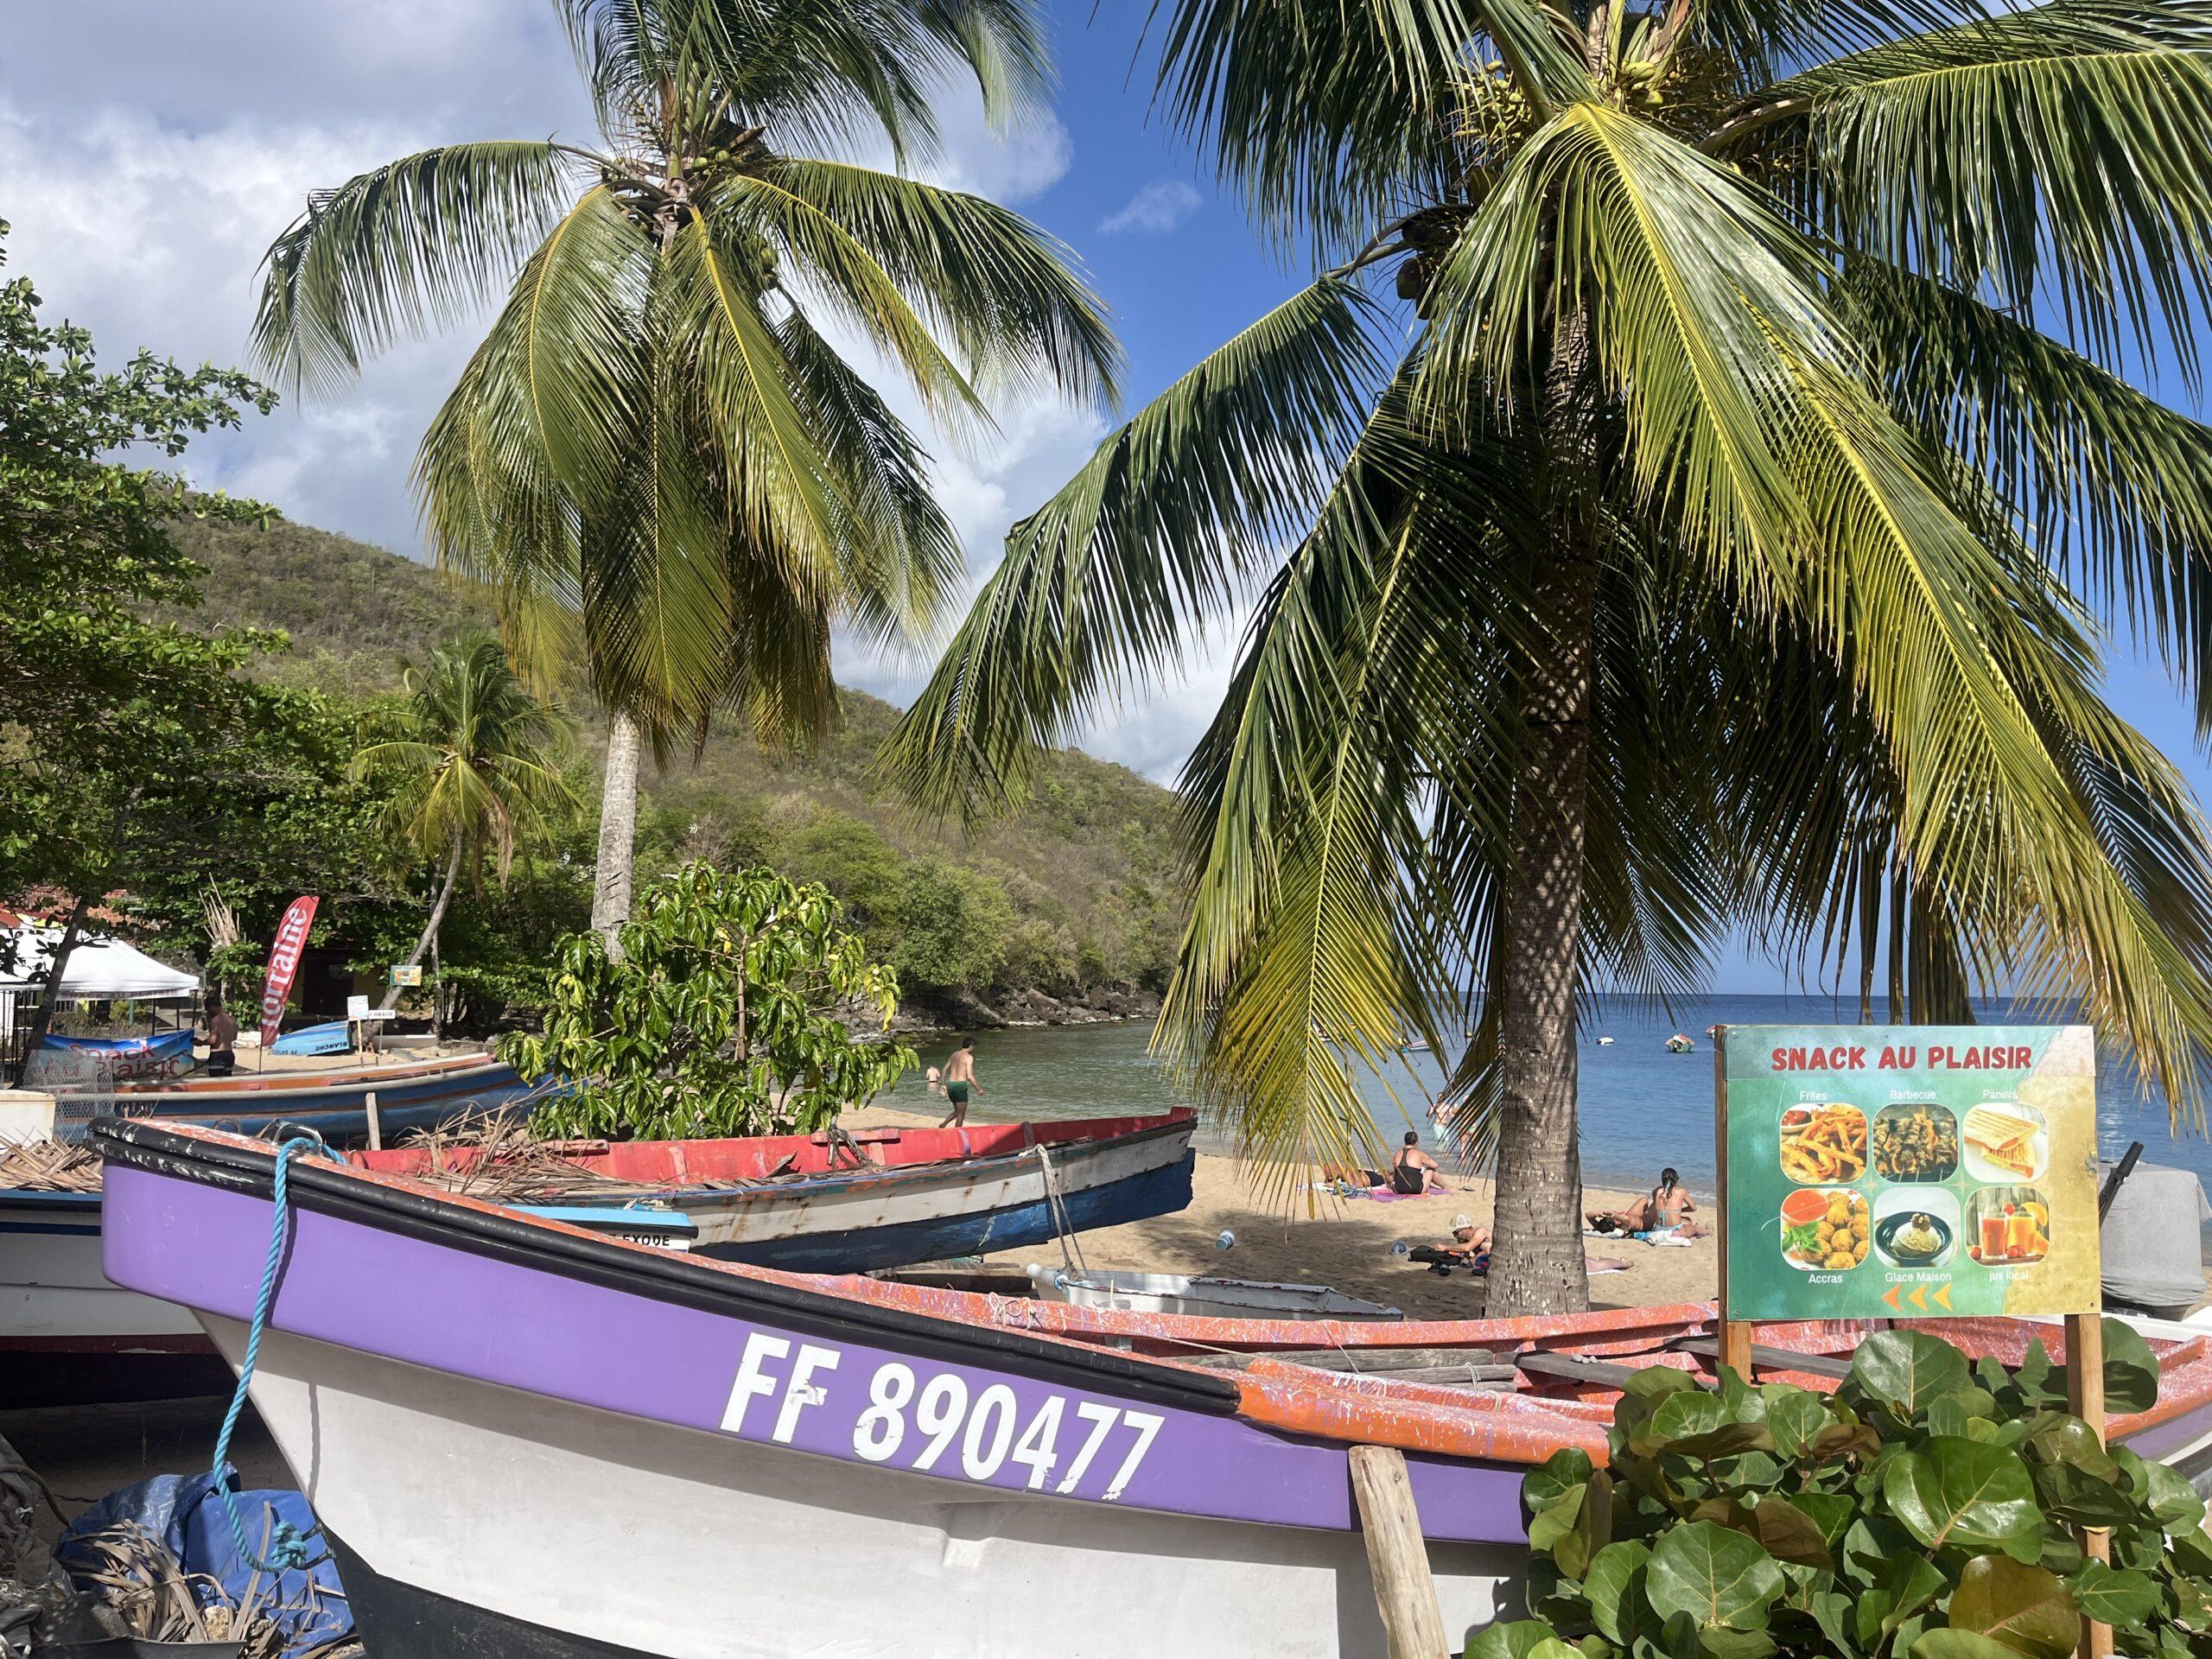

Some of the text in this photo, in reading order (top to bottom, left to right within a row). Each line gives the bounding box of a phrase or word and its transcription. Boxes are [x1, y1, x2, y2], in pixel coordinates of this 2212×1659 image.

[315, 1040, 348, 1052] BLANCHE
[68, 1043, 156, 1063] Snack
[1771, 1046, 2032, 1071] SNACK AU PLAISIR
[1799, 1090, 1827, 1102] Frites
[1890, 1089, 1936, 1100] Barbecue
[1982, 1089, 2018, 1100] Paninis
[1808, 1273, 1843, 1284] Accras
[1885, 1271, 1952, 1283] Glace Maison
[1989, 1269, 2029, 1281] jus local
[720, 1332, 1166, 1501] FF 890477
